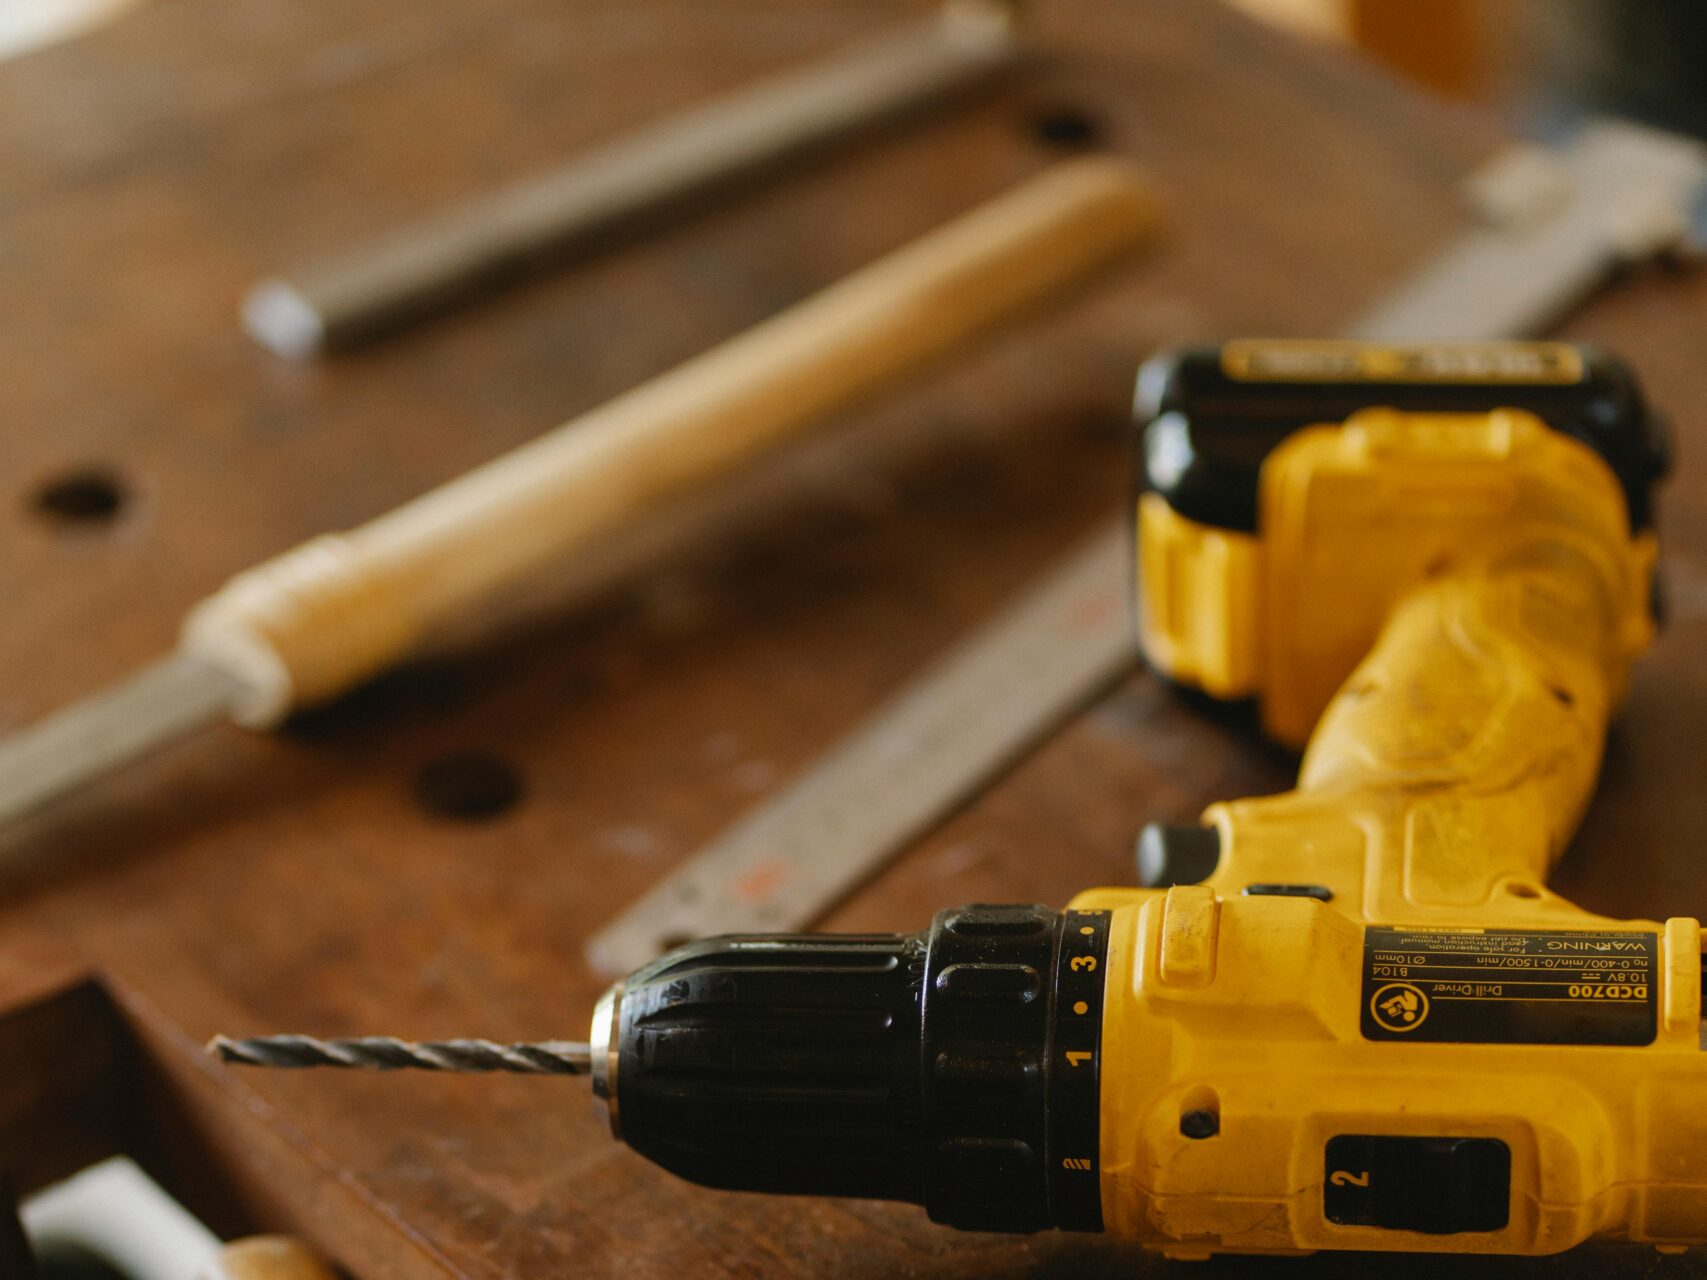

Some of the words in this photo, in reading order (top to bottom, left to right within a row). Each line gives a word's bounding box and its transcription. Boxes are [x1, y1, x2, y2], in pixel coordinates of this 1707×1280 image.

[1547, 941, 1646, 952] WARNING
[1071, 956, 1097, 972] 3
[1373, 966, 1408, 976] B104
[1607, 972, 1646, 982] 10.8V
[1432, 984, 1472, 994] Driver
[1476, 985, 1502, 996] Drill
[1568, 985, 1648, 998] DCD700
[1066, 1052, 1092, 1067] 1
[1330, 1171, 1369, 1187] 2
